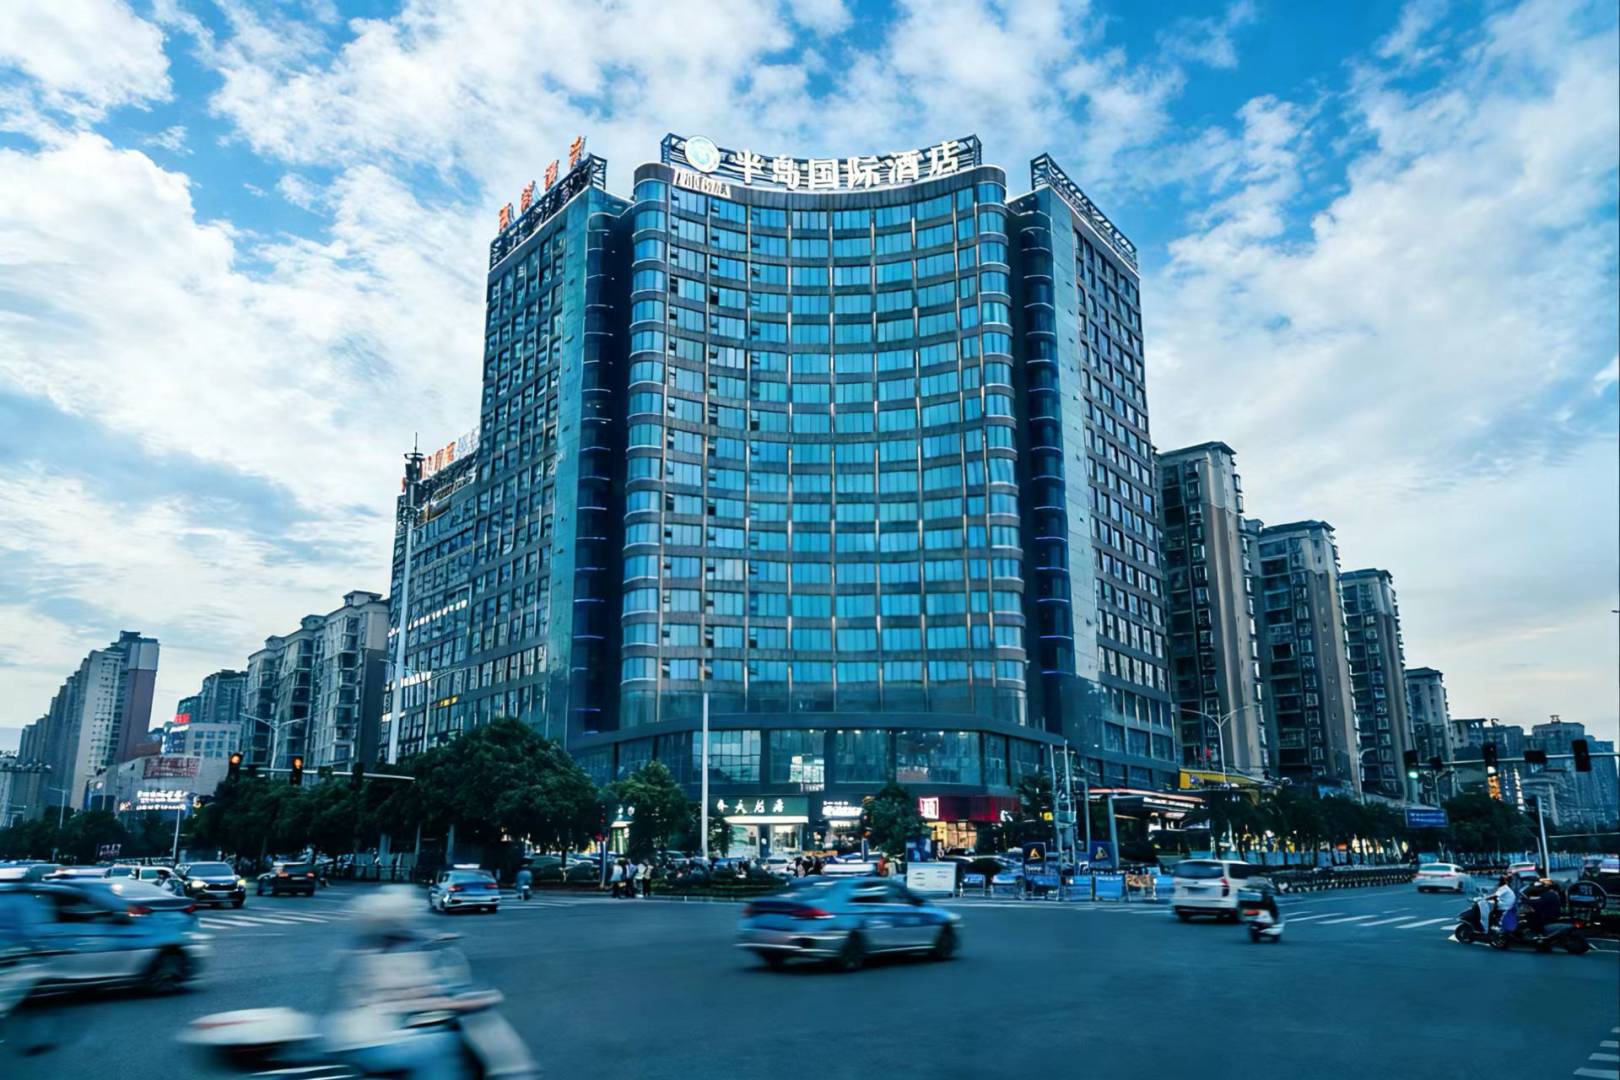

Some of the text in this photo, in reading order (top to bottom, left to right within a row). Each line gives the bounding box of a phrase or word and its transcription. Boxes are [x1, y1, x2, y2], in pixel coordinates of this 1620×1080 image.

[730, 141, 960, 190] 半岛国际酒店
